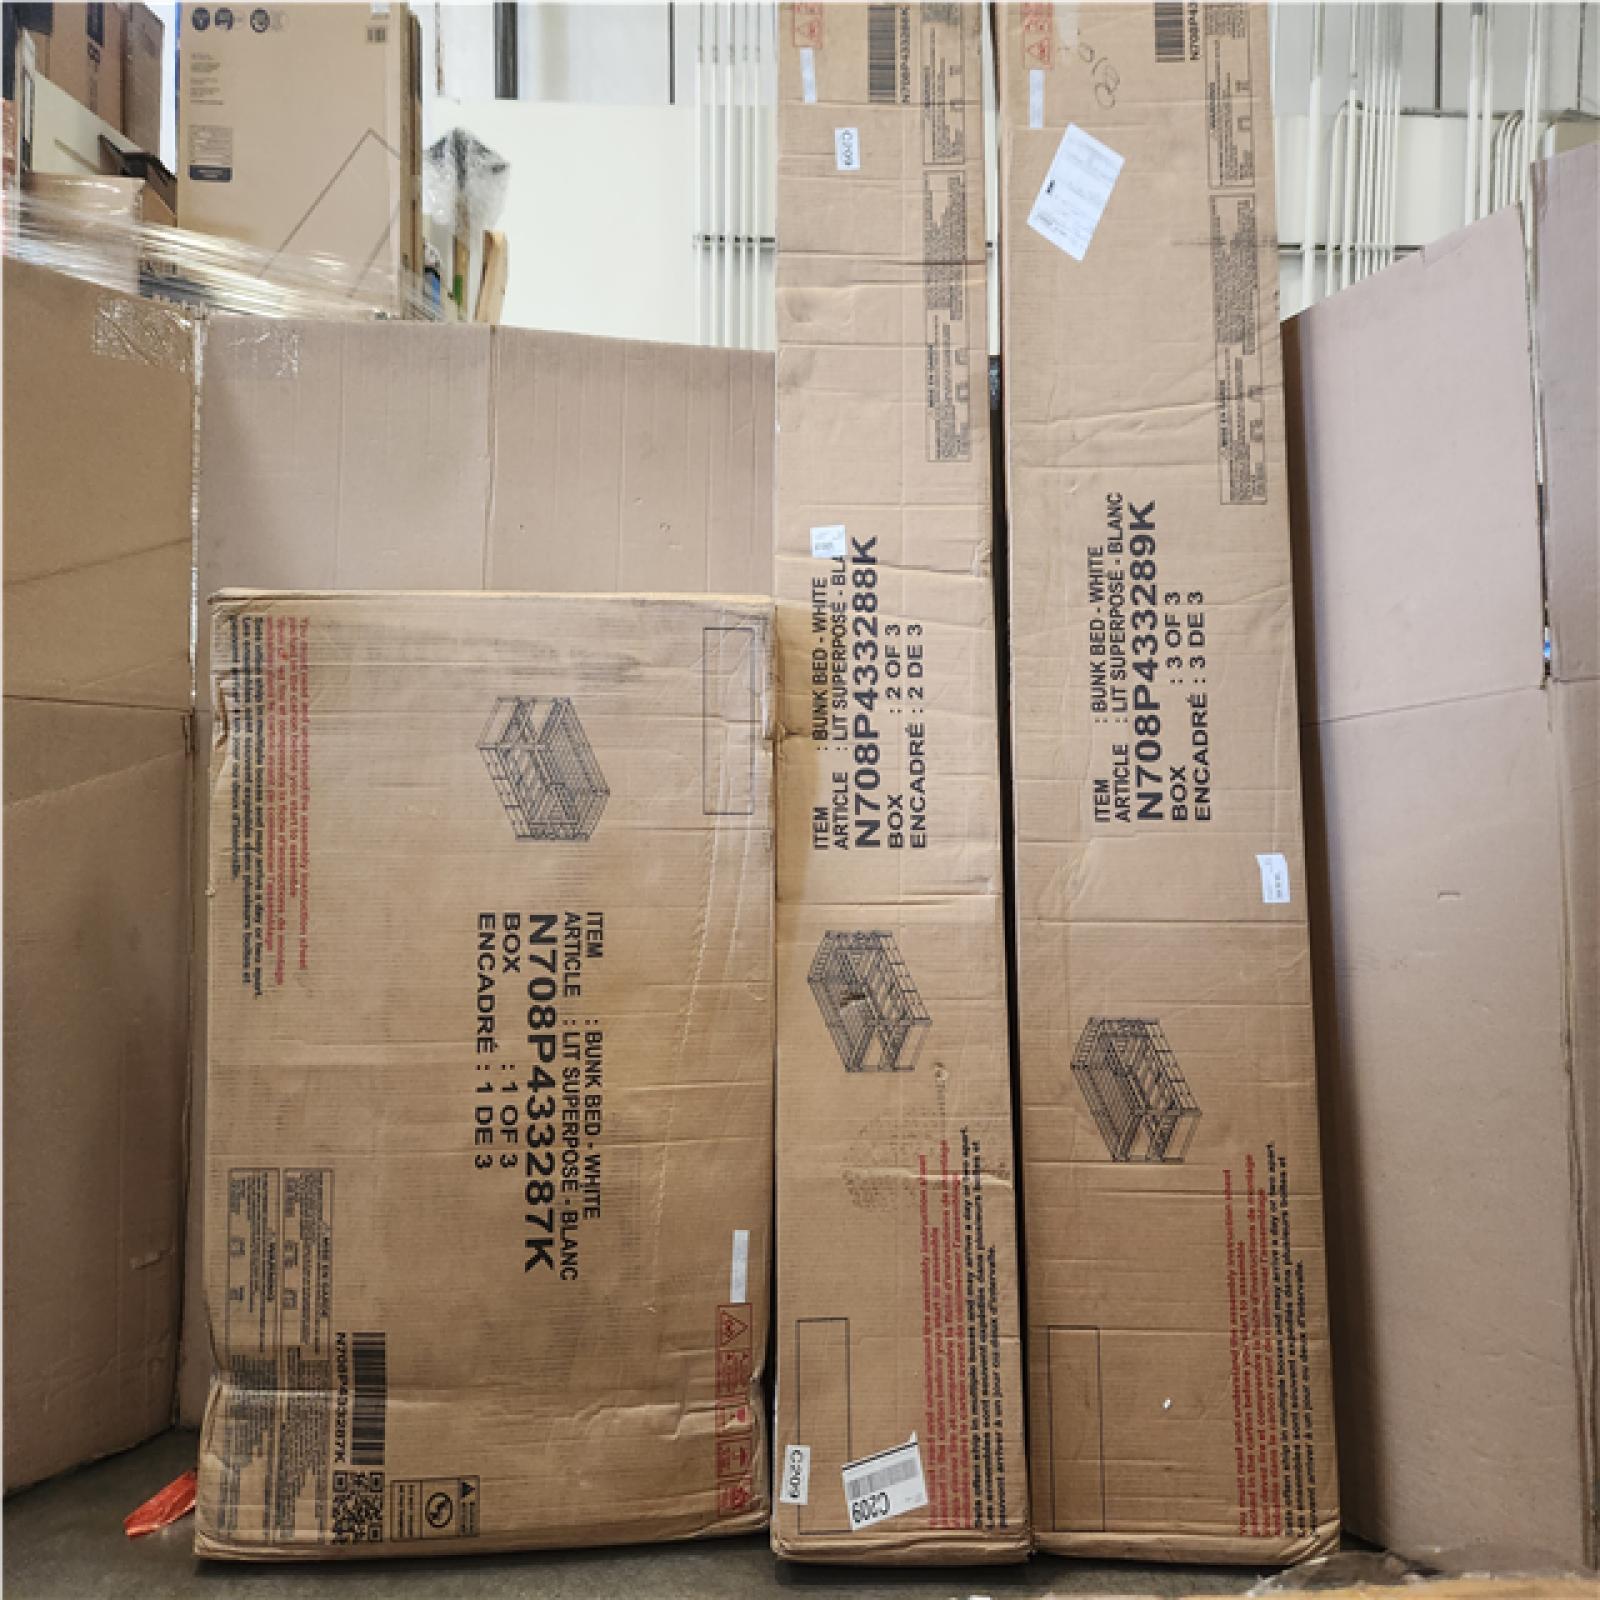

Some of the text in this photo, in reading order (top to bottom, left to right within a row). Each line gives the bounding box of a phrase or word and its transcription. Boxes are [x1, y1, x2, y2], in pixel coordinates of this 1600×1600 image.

[1107, 493, 1123, 553] BLANC
[830, 556, 846, 585] BLA
[1088, 545, 1105, 603] WHITE
[812, 578, 827, 633] WHITE
[1165, 592, 1180, 605] 3
[1187, 592, 1203, 605] 3
[885, 625, 900, 635] 3
[907, 625, 922, 635] 3
[1090, 619, 1105, 655] BED
[1105, 570, 1127, 680] SUPERPOSÉ
[1165, 613, 1182, 648] OF
[1187, 613, 1205, 647] DE
[812, 648, 828, 685] BED
[827, 603, 847, 710] SUPERPOSÉ
[885, 645, 900, 678] OF
[907, 645, 923, 678] DE
[1128, 501, 1163, 820] N708P433289K
[1167, 656, 1183, 668] 3
[1190, 655, 1205, 668] 3
[852, 537, 880, 847] N708P433288K
[885, 687, 900, 700] 2
[908, 687, 923, 699] 2
[1090, 661, 1107, 712] BUNK
[1110, 686, 1128, 712] LIT
[812, 690, 828, 740] BUNK
[832, 715, 848, 740] LIT
[1187, 693, 1210, 820] ENCADRÉ
[905, 723, 927, 848] ENCADRÉ
[1094, 780, 1110, 822] ITEM
[1112, 745, 1130, 823] ARTICLE
[1170, 765, 1188, 820] BOX
[813, 807, 828, 850] ITEM
[833, 772, 848, 850] ARTICLE
[888, 795, 903, 848] BOX
[503, 913, 520, 973] BOX
[563, 912, 581, 997] ARTICLE
[586, 912, 603, 958] ITEM
[477, 913, 498, 1053] ENCADRÉ
[563, 1032, 580, 1060] LIT
[585, 1032, 602, 1088] BUNK
[477, 1082, 493, 1093] 1
[502, 1082, 518, 1092] 1
[525, 915, 557, 1273] N708P433287K
[475, 1107, 493, 1145] DE
[500, 1105, 518, 1143] OF
[561, 1067, 582, 1192] SUPERPOSÉ
[585, 1095, 602, 1135] BED
[475, 1155, 493, 1169] 3
[500, 1154, 518, 1168] 3
[583, 1155, 600, 1220] WHITE
[560, 1210, 578, 1280] BLANC
[852, 1492, 890, 1523] C209
